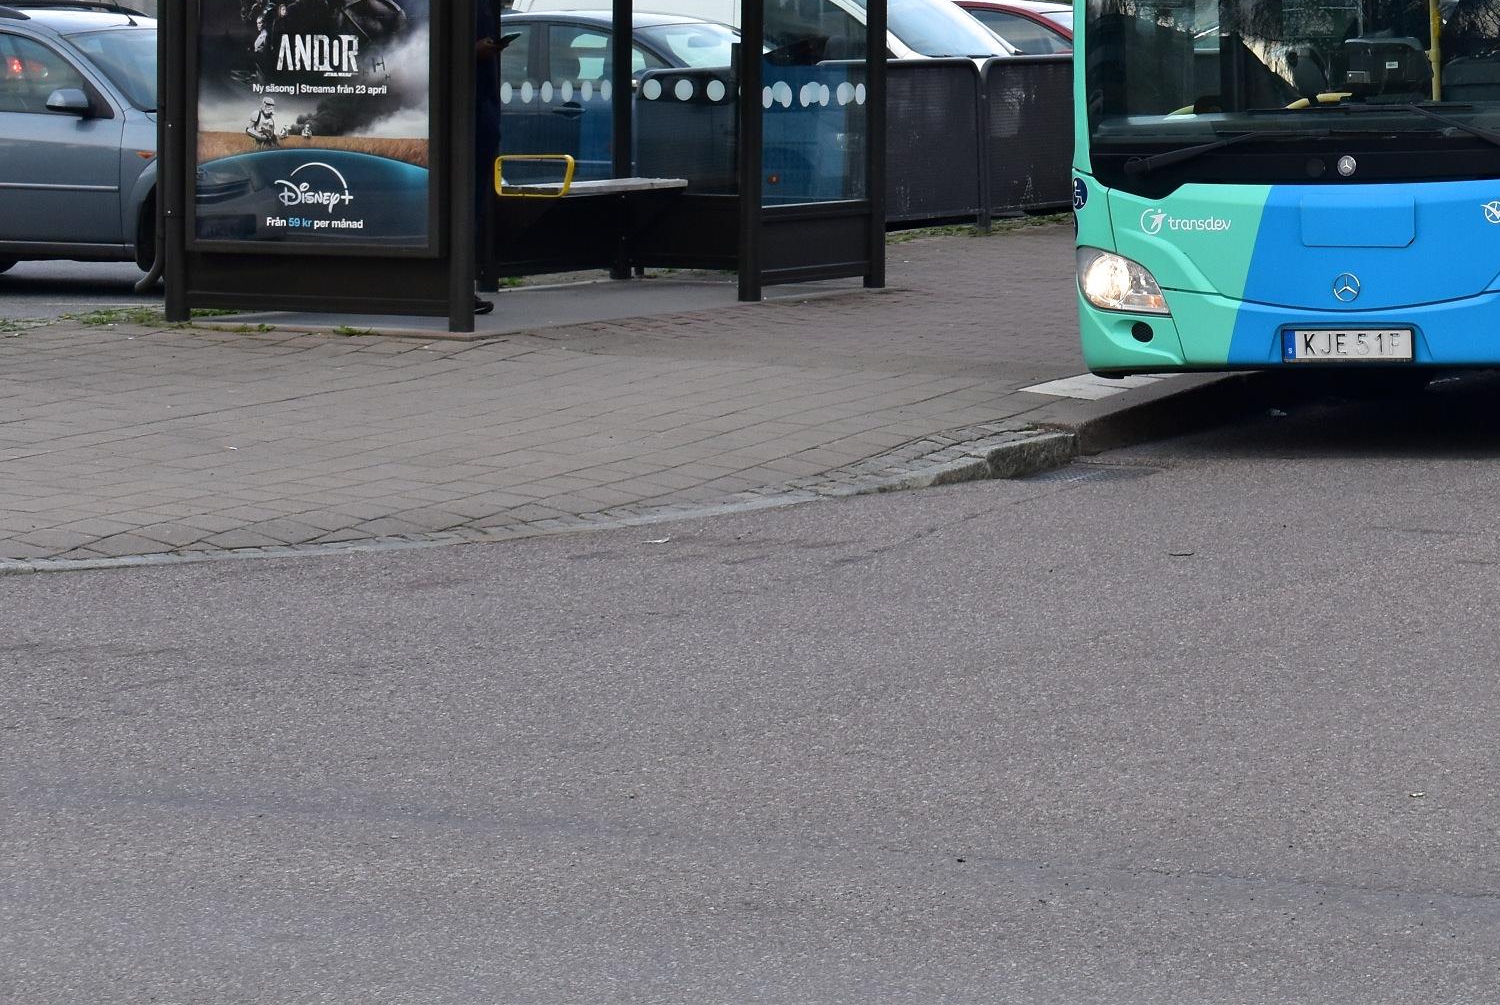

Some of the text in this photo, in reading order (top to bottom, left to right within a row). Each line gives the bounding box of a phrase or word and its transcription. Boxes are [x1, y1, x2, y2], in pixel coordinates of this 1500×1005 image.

[276, 34, 359, 72] ANDOR
[252, 83, 264, 94] Ny
[265, 83, 295, 94] säsong
[300, 84, 336, 94] Streama
[337, 84, 354, 94] från
[355, 85, 366, 94] 23
[367, 85, 387, 96] april
[274, 179, 354, 213] Disney+
[266, 217, 364, 229] Från 59 kr per månad
[1168, 216, 1232, 231] transdev
[1303, 333, 1347, 356] KJE
